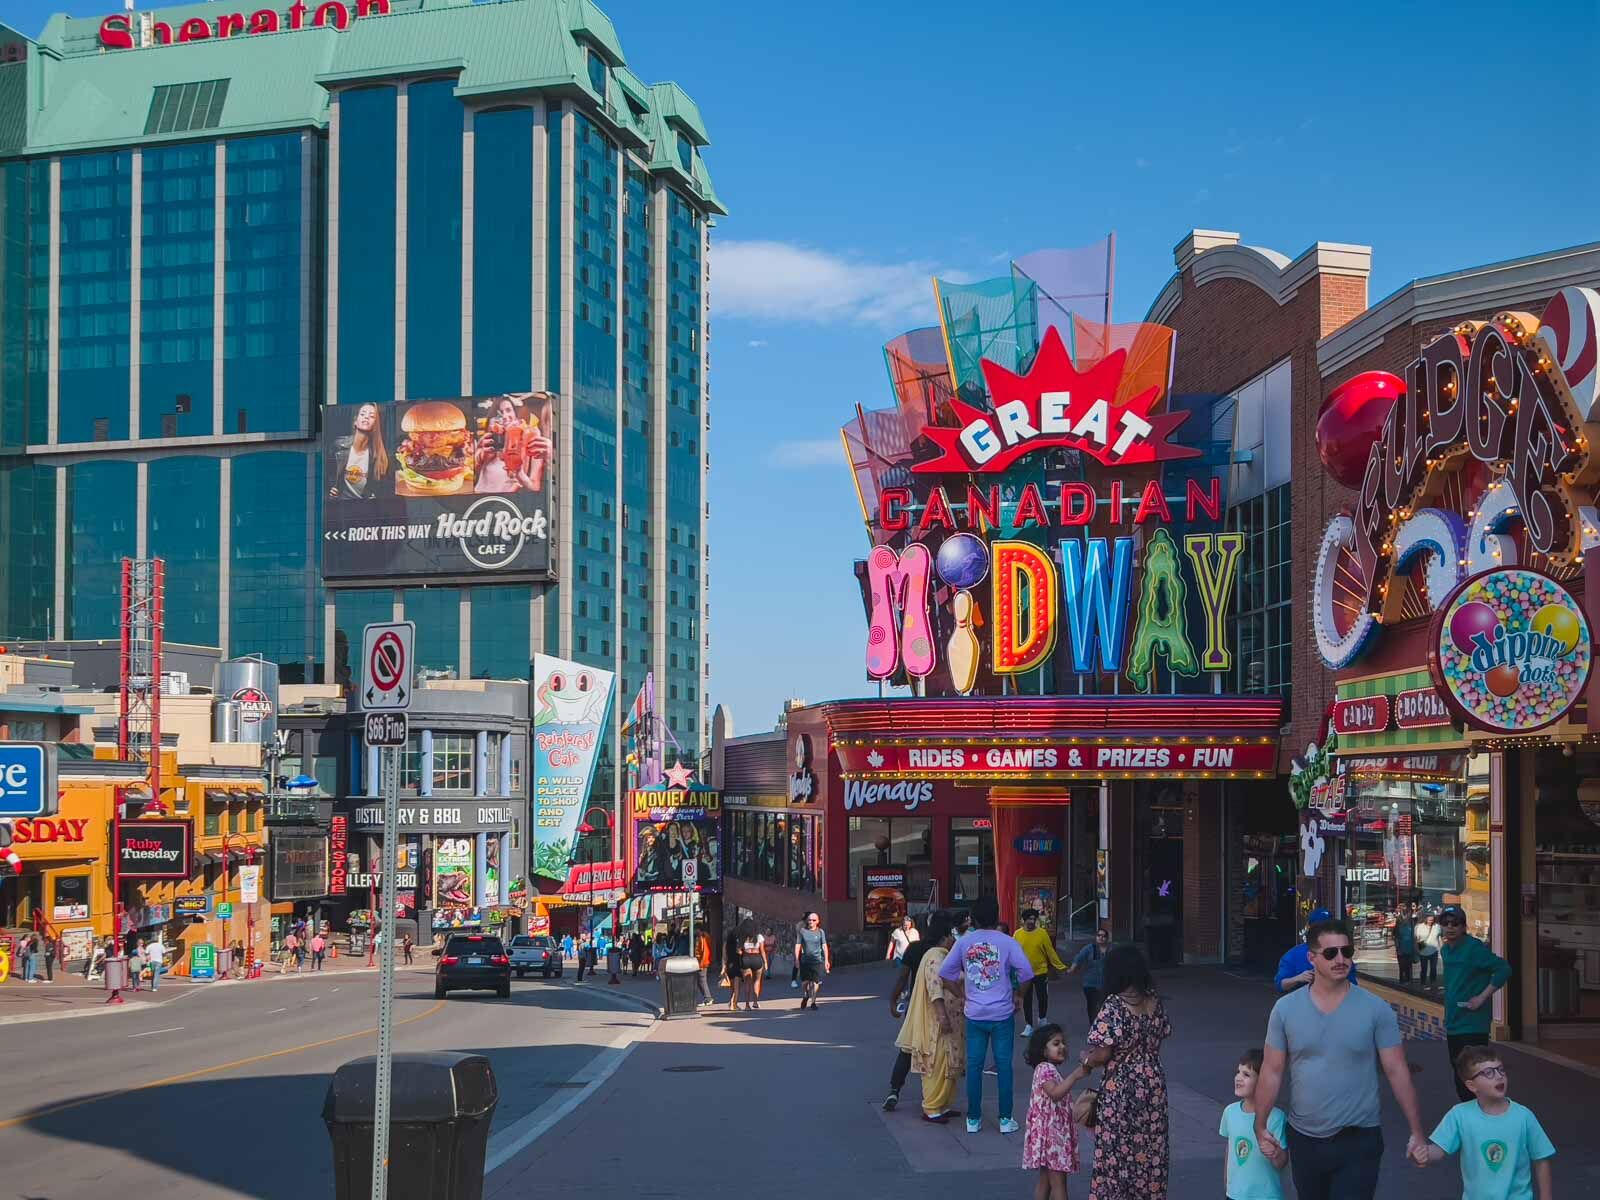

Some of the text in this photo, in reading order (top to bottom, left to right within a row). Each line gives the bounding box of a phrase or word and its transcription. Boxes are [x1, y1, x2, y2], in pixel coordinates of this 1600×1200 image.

[100, 0, 391, 49] Sheraton
[960, 391, 1152, 464] GREAT
[1349, 323, 1567, 614] FUDGE
[879, 478, 1221, 530] CANADIAN
[348, 524, 431, 541] ROCK THIS WAY
[436, 509, 547, 541] Hard Rock
[478, 544, 507, 555] CAFE
[866, 527, 1244, 695] MIDWAY
[1472, 623, 1567, 673] dippin'
[1519, 663, 1557, 684] dots
[368, 716, 405, 741] $66 Fine
[536, 730, 594, 751] Rainforest
[548, 748, 580, 768] Cafe
[909, 748, 1234, 767] RIDES GAMES & PRIZES FUN
[538, 777, 583, 785] A WILD
[538, 787, 577, 795] PLACE
[538, 798, 578, 806] TO SHOP
[635, 791, 719, 812] MOVIELAND
[844, 779, 934, 810] Wendy's
[355, 808, 415, 824] DISTILRY
[420, 808, 430, 824] &
[434, 808, 461, 824] BBQ
[538, 808, 564, 817] AND
[538, 819, 561, 827] EAT
[121, 848, 179, 861] Tuesday
[126, 838, 162, 851] Ruby
[438, 838, 470, 857] 4D
[332, 850, 345, 895] STORE
